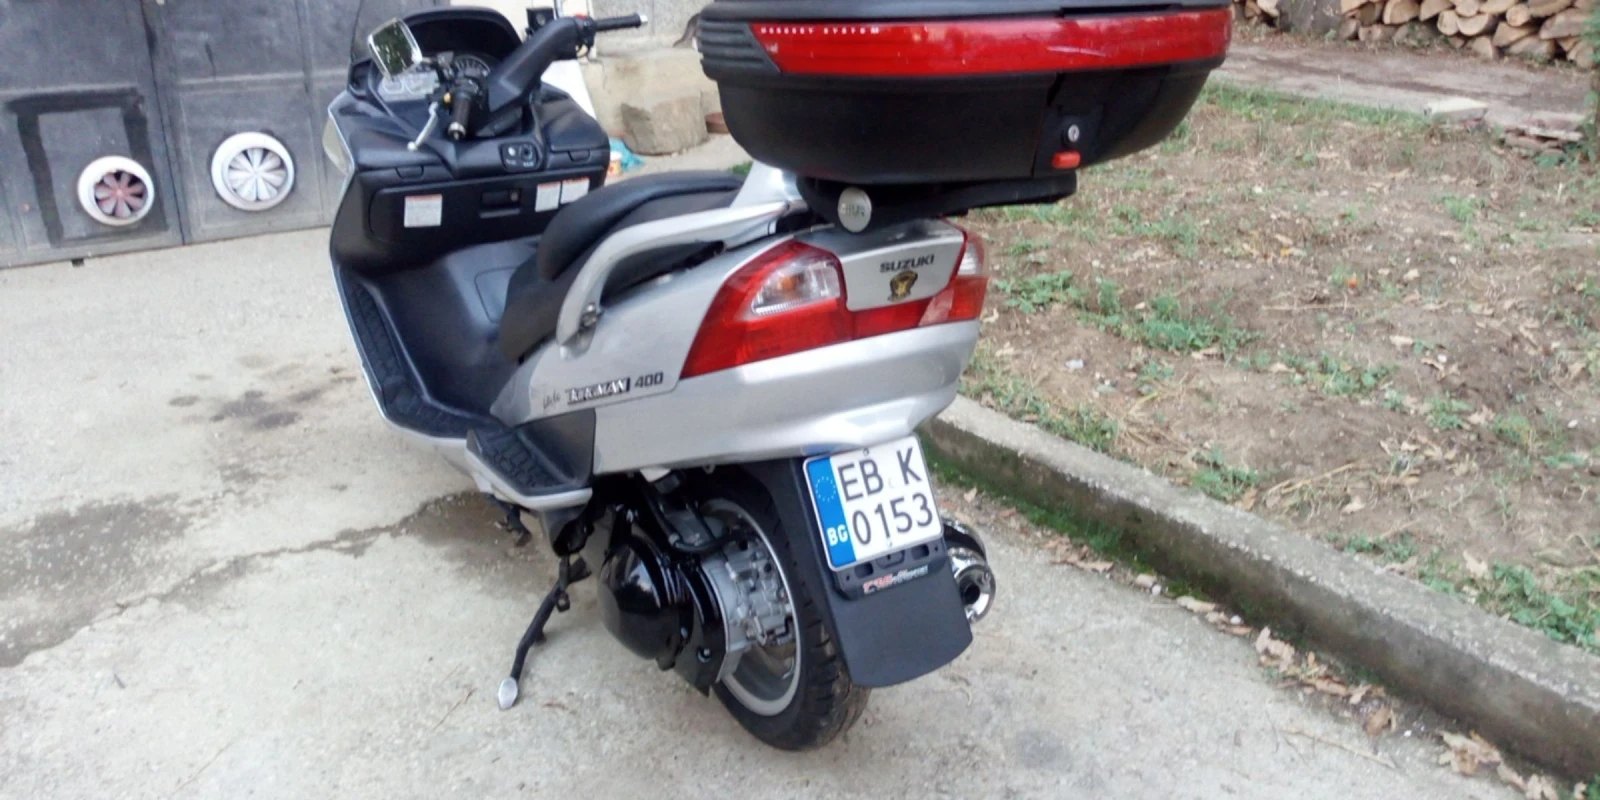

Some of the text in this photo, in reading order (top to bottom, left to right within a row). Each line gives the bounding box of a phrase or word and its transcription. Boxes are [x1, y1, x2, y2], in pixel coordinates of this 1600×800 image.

[880, 254, 935, 273] SUZUKI
[634, 371, 664, 389] 400
[837, 446, 922, 502] EB K
[851, 492, 933, 546] 0153
[826, 523, 849, 547] BG
